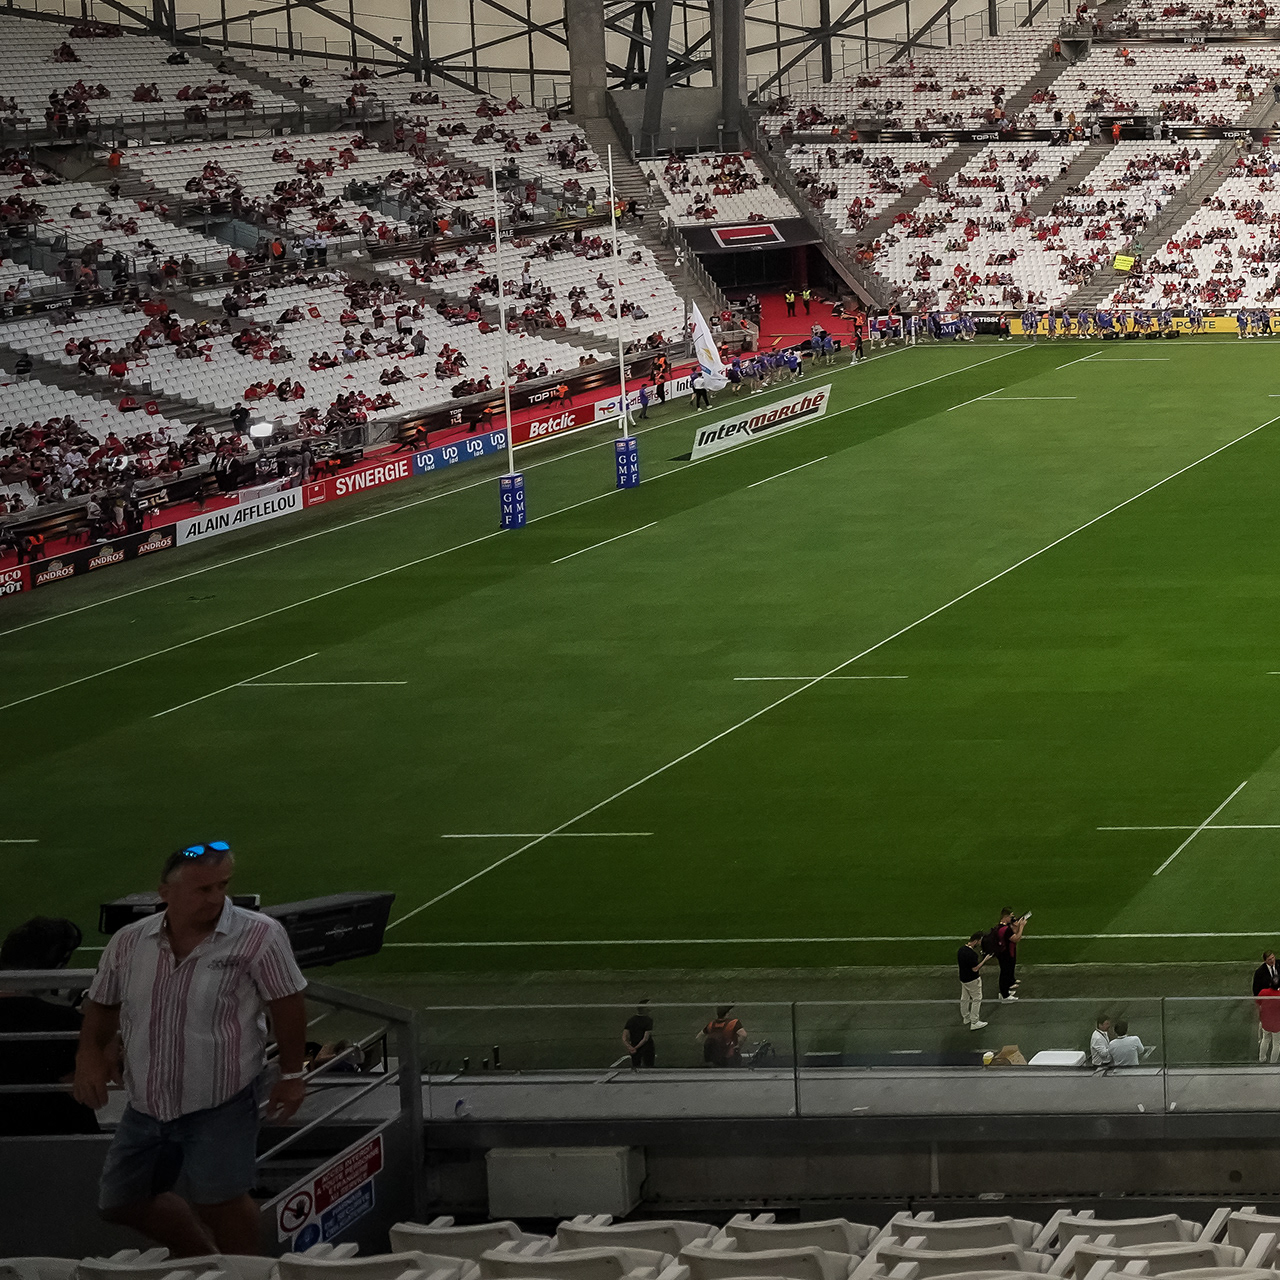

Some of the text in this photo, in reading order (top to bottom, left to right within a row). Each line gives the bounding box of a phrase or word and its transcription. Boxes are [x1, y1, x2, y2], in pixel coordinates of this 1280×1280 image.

[490, 230, 514, 240] FALE
[1176, 320, 1216, 329] POTE
[529, 412, 576, 438] Betclic
[336, 460, 409, 496] SYNERGIE
[186, 494, 296, 539] ALAIN AFFLELOU
[138, 536, 172, 554] ANDROS
[89, 550, 124, 568] ANDROS
[36, 566, 74, 584] ANDROS
